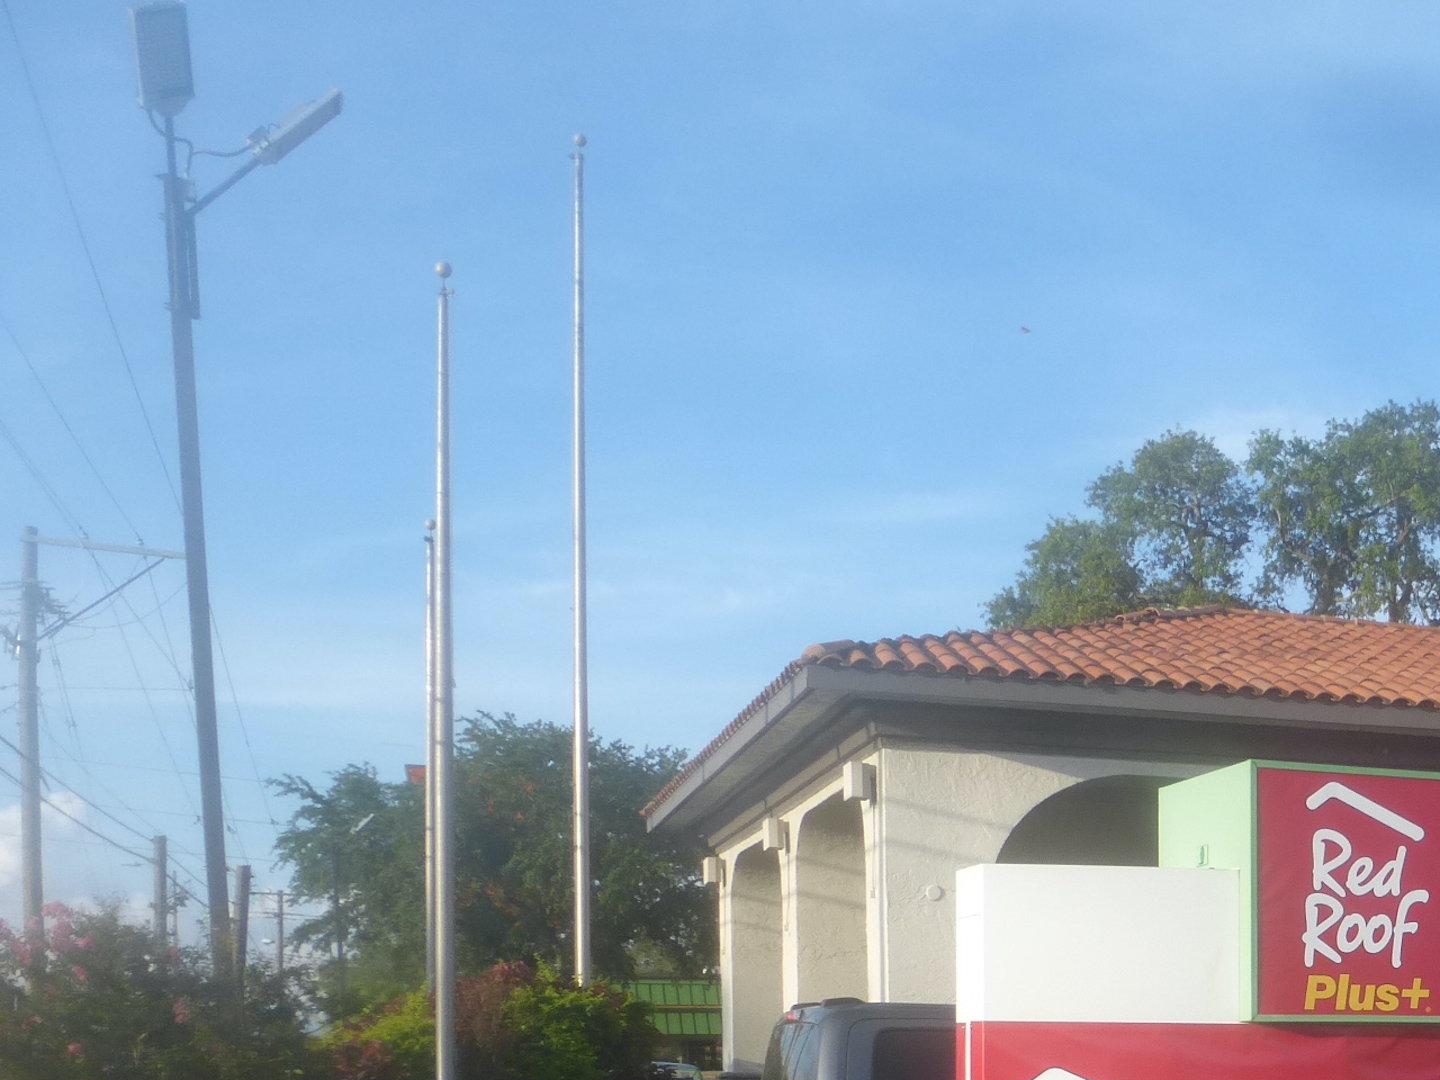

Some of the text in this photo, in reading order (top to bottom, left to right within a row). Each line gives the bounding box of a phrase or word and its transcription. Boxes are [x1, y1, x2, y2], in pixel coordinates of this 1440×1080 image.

[1312, 827, 1407, 899] Red
[1301, 889, 1429, 968] Roof
[1304, 973, 1431, 1012] Plus+
